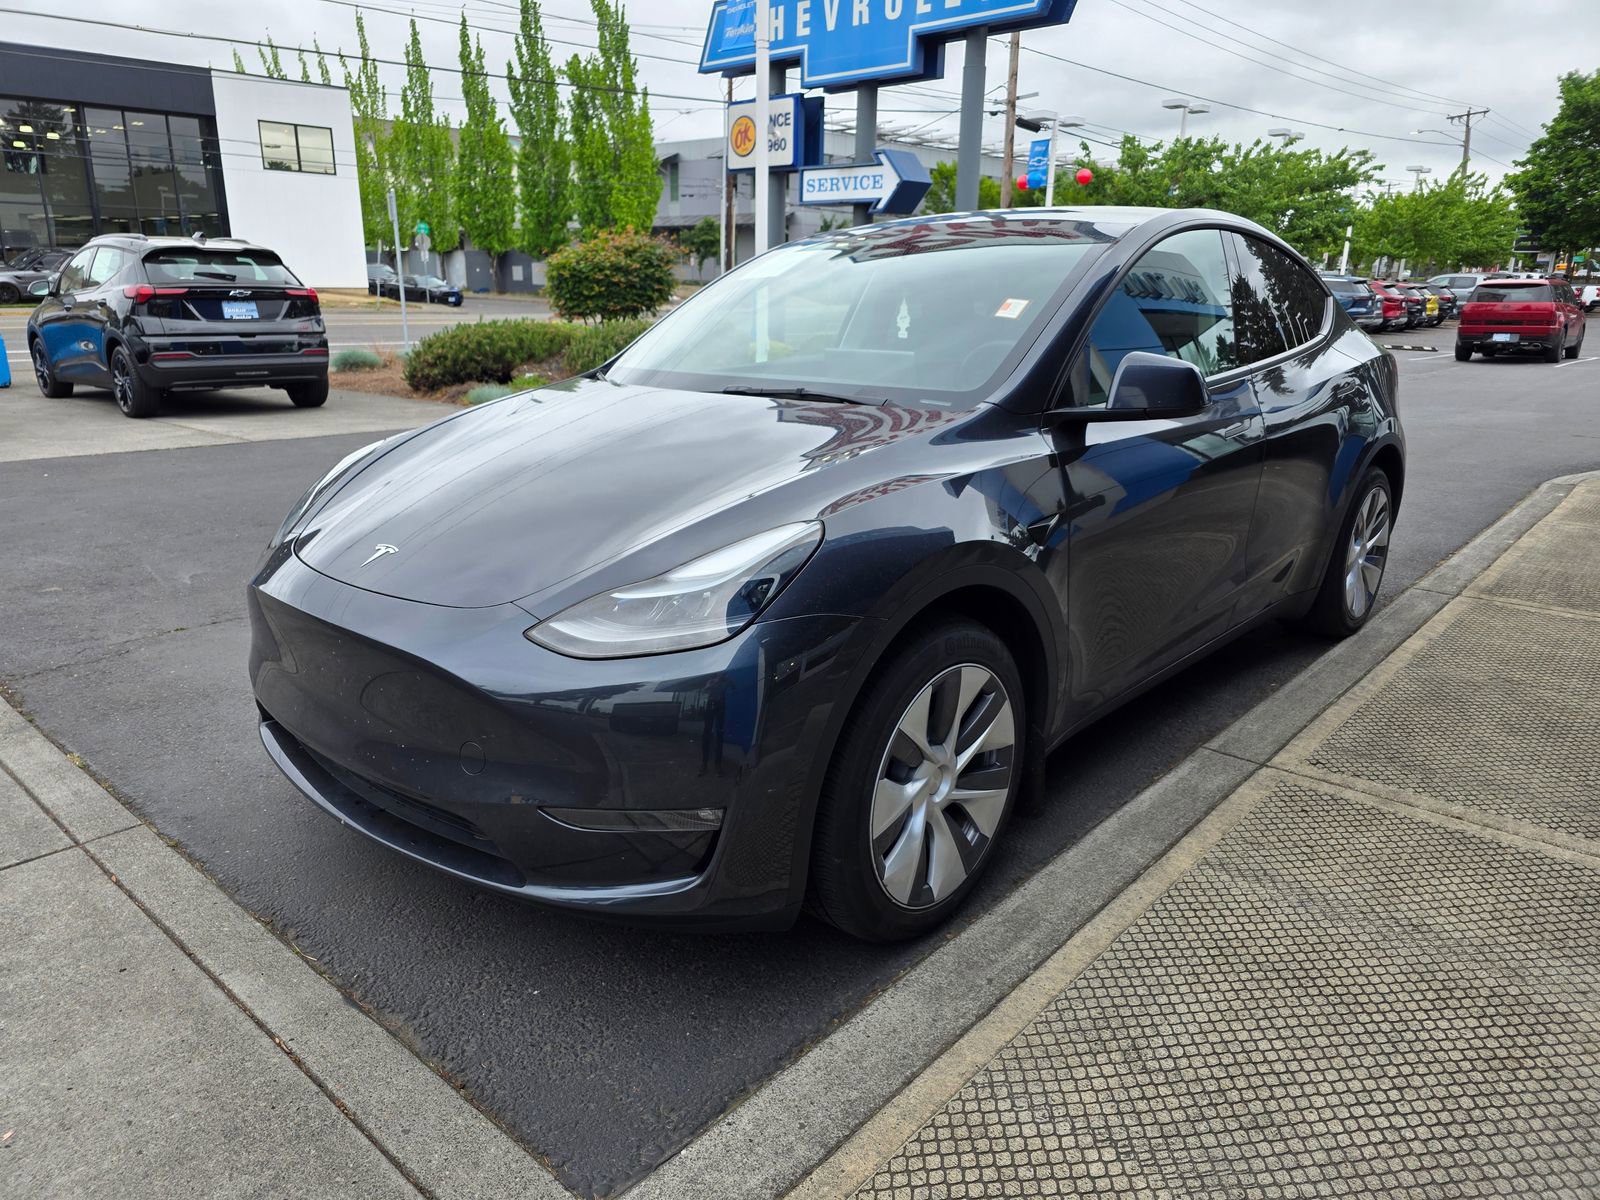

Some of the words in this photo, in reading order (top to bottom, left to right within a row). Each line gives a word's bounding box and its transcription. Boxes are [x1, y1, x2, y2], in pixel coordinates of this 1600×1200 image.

[768, 112, 791, 127] NCE
[735, 122, 752, 149] OK
[768, 137, 787, 152] 960
[806, 174, 883, 192] SERVICE
